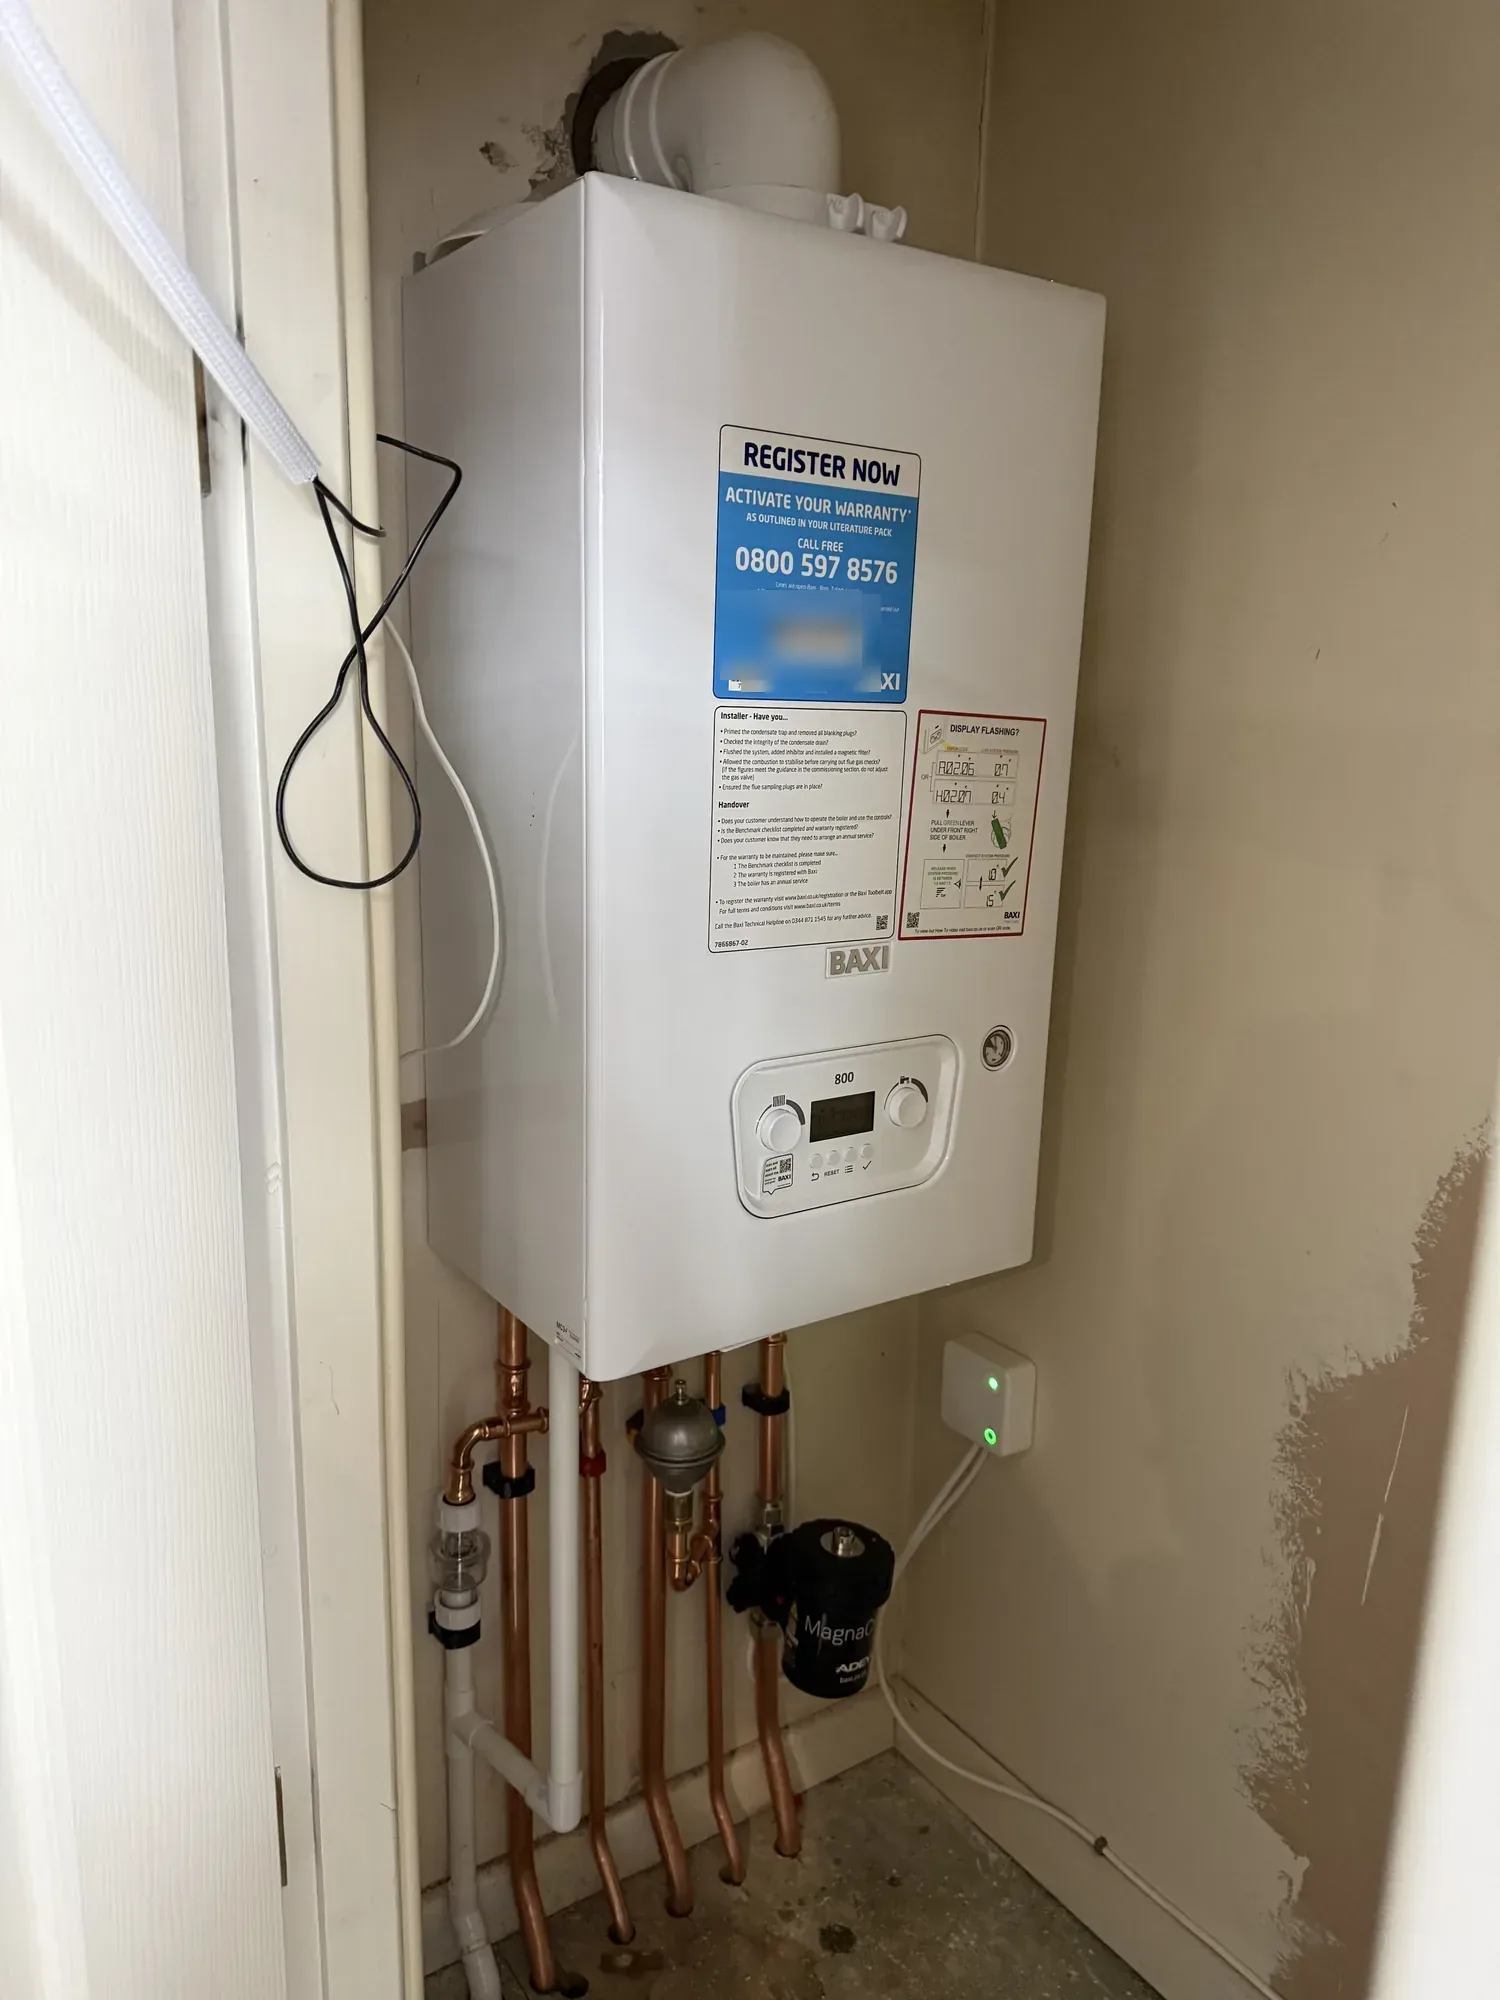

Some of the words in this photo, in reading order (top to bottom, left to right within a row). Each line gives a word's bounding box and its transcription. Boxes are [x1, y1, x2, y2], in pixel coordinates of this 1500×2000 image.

[744, 442, 845, 479] REGISTER
[853, 458, 900, 486] NOW
[725, 487, 791, 509] ACTIVATE
[795, 495, 831, 514] YOUR
[746, 513, 757, 521] AS
[759, 514, 796, 526] OUTLINED
[798, 518, 806, 527] IN
[808, 519, 828, 530] YOUR
[830, 522, 872, 535] LITERATURE
[874, 528, 892, 537] PACK
[798, 538, 819, 550] CALL
[822, 541, 844, 552] FREE
[736, 547, 793, 575] 0800
[801, 553, 840, 578] 597
[847, 558, 897, 584] 8576
[881, 672, 900, 690] XI
[950, 724, 980, 733] DISPLAY
[981, 727, 1019, 736] FLASHING?
[830, 946, 889, 975] BAXI
[834, 1071, 854, 1085] 800
[824, 1169, 840, 1177] RESET
